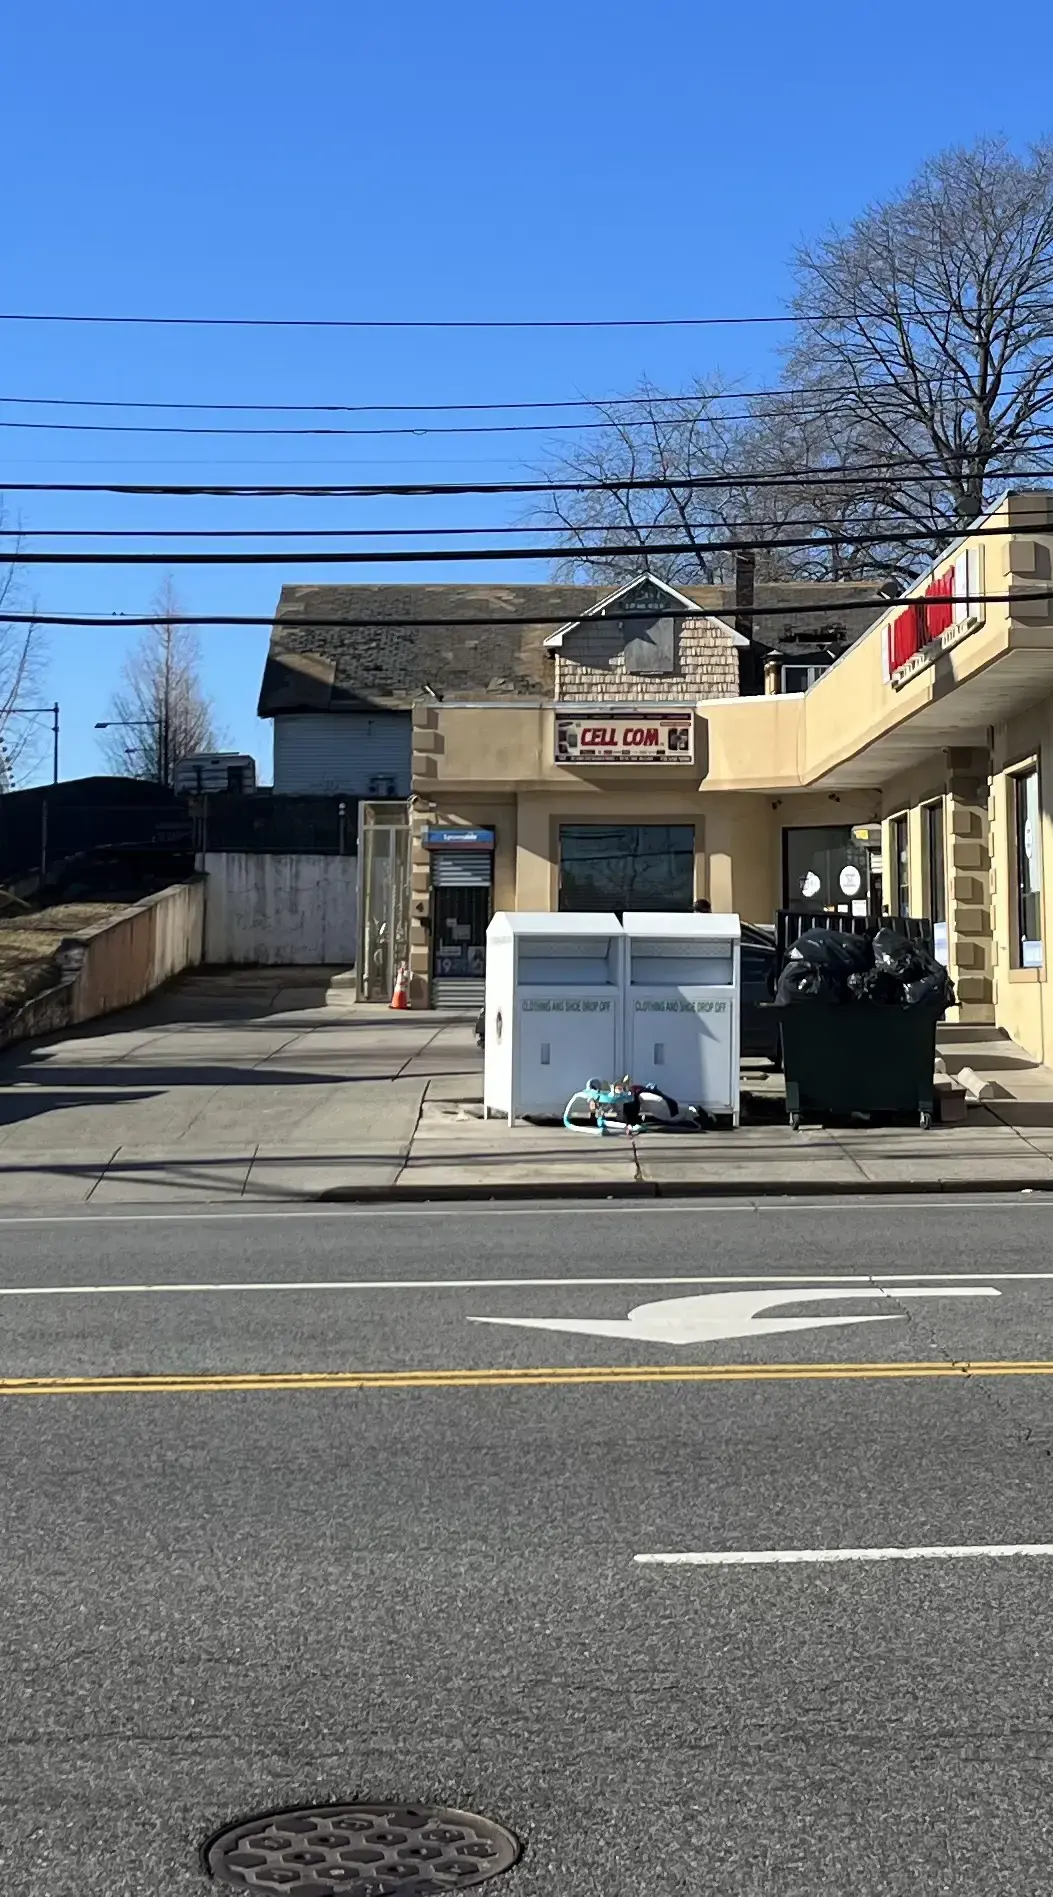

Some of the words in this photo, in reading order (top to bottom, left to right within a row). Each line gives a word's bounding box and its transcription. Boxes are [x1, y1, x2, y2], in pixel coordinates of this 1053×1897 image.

[580, 728, 618, 747] CELL
[622, 728, 659, 747] COM
[522, 1000, 551, 1012] CLOTHING
[565, 1000, 581, 1013] SHOE
[582, 1001, 599, 1012] DROP
[600, 1001, 611, 1012] OFF
[635, 1000, 665, 1012] CLOTHING
[666, 1001, 679, 1012] AND
[680, 1001, 696, 1013] SHOE
[697, 1001, 714, 1013] DROP
[715, 1002, 726, 1013] OFF
